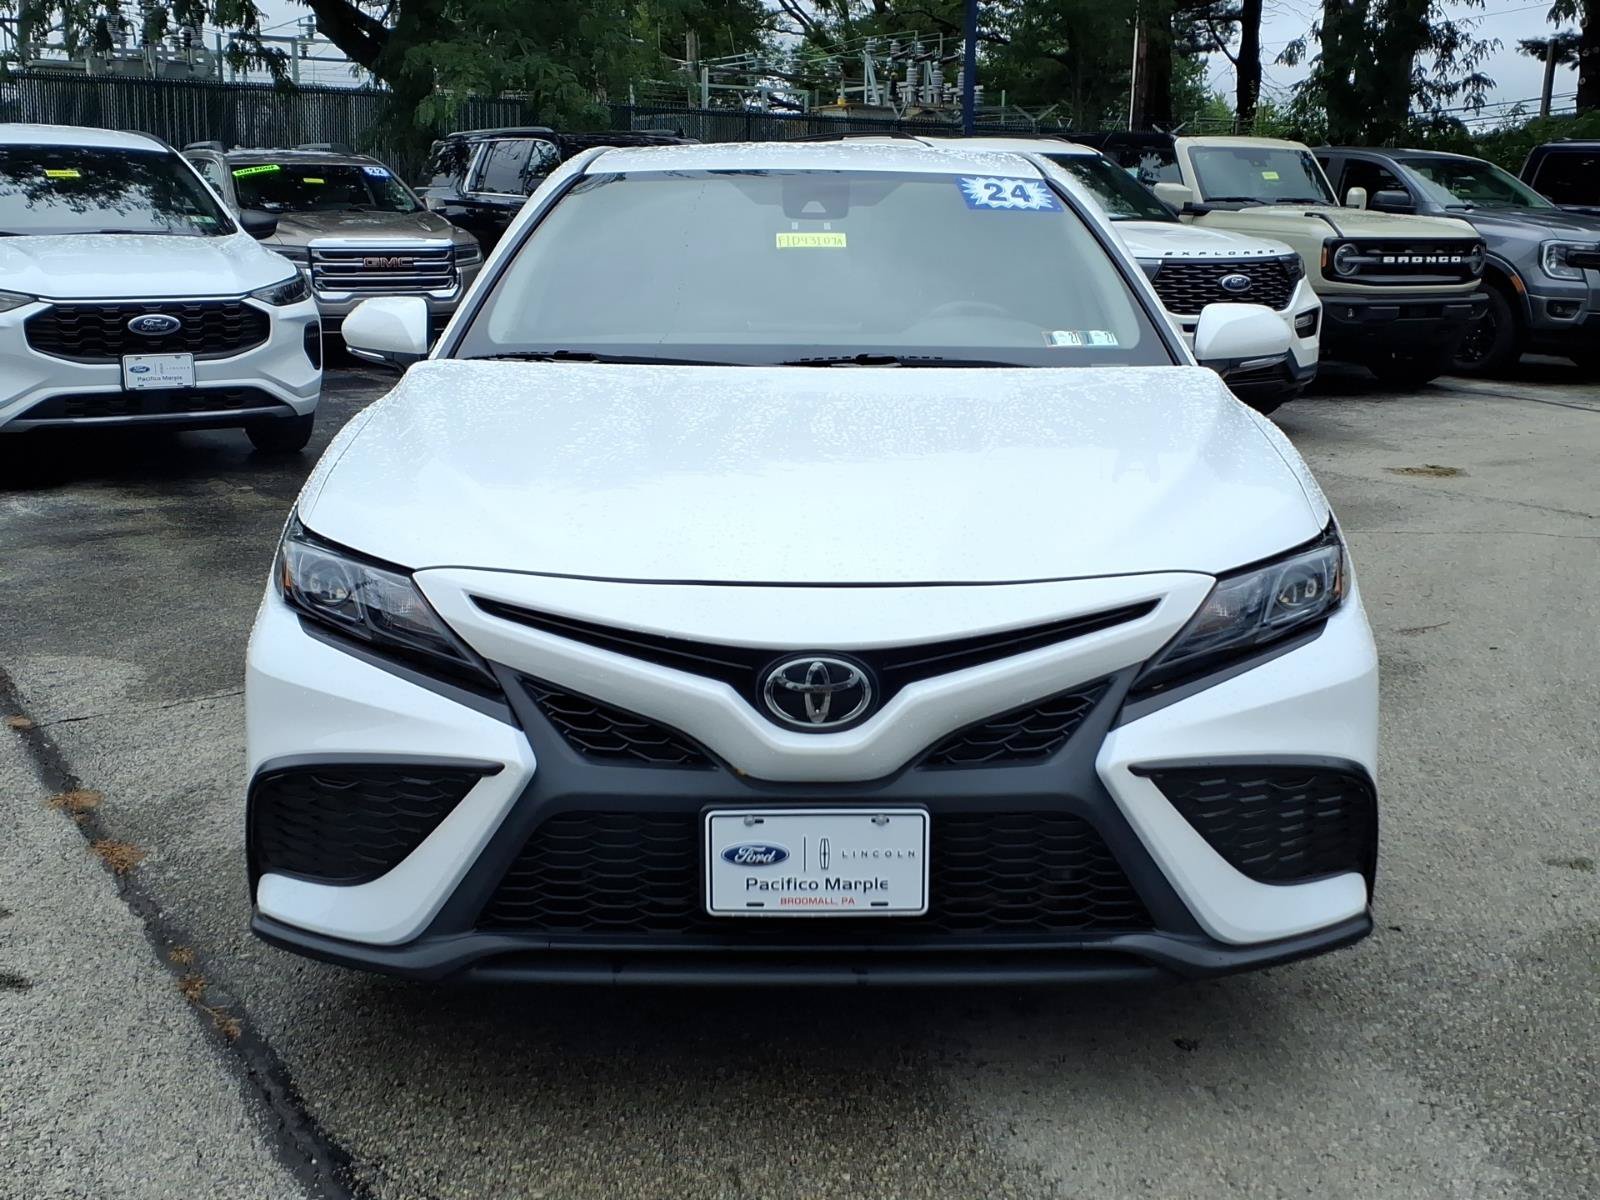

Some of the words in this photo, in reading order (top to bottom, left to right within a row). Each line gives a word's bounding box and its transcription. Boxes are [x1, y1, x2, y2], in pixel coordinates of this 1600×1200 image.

[983, 182, 1031, 203] 24
[364, 256, 414, 268] GMC
[734, 846, 777, 864] Ford
[842, 850, 916, 859] LINCOLN
[746, 876, 819, 892] Pacifico
[825, 877, 889, 894] Marple
[842, 897, 856, 905] PA
